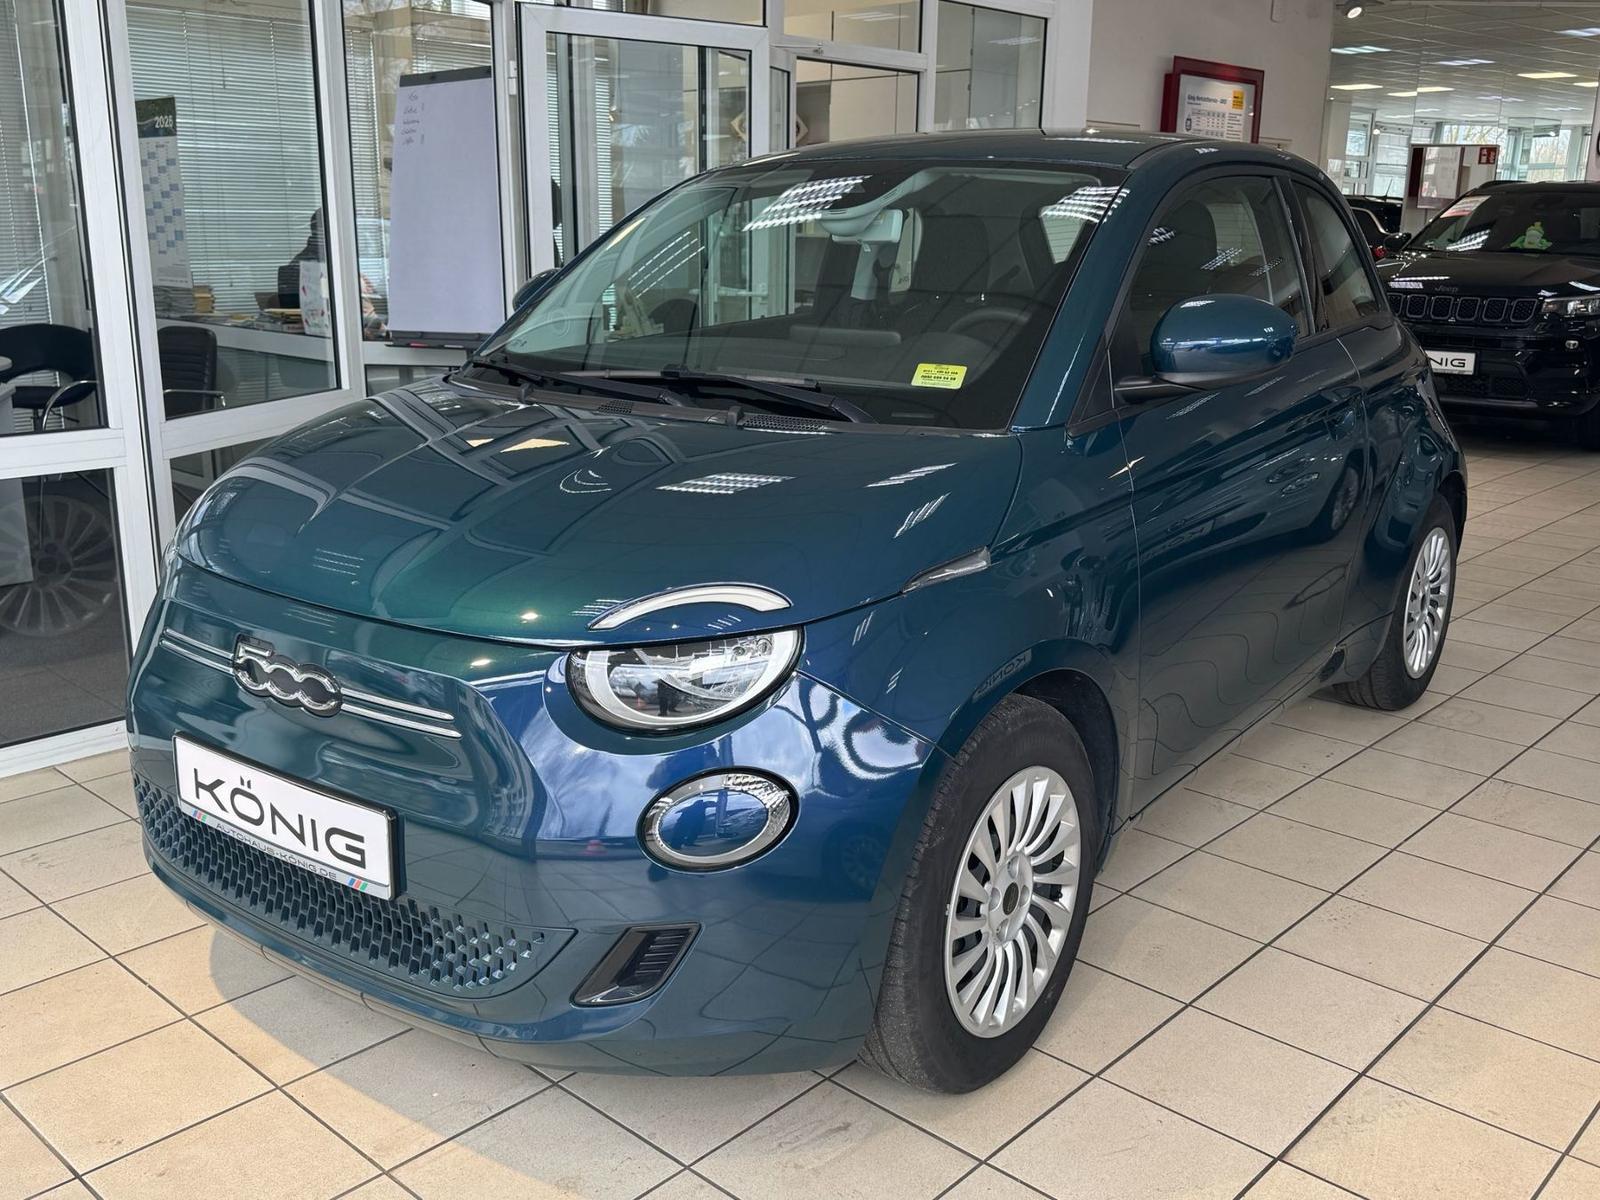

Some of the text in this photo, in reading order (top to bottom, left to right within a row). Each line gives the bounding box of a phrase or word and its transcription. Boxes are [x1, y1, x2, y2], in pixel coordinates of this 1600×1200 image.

[1429, 357, 1466, 368] NIG
[233, 636, 341, 715] 500
[193, 767, 367, 870] KÖNIG
